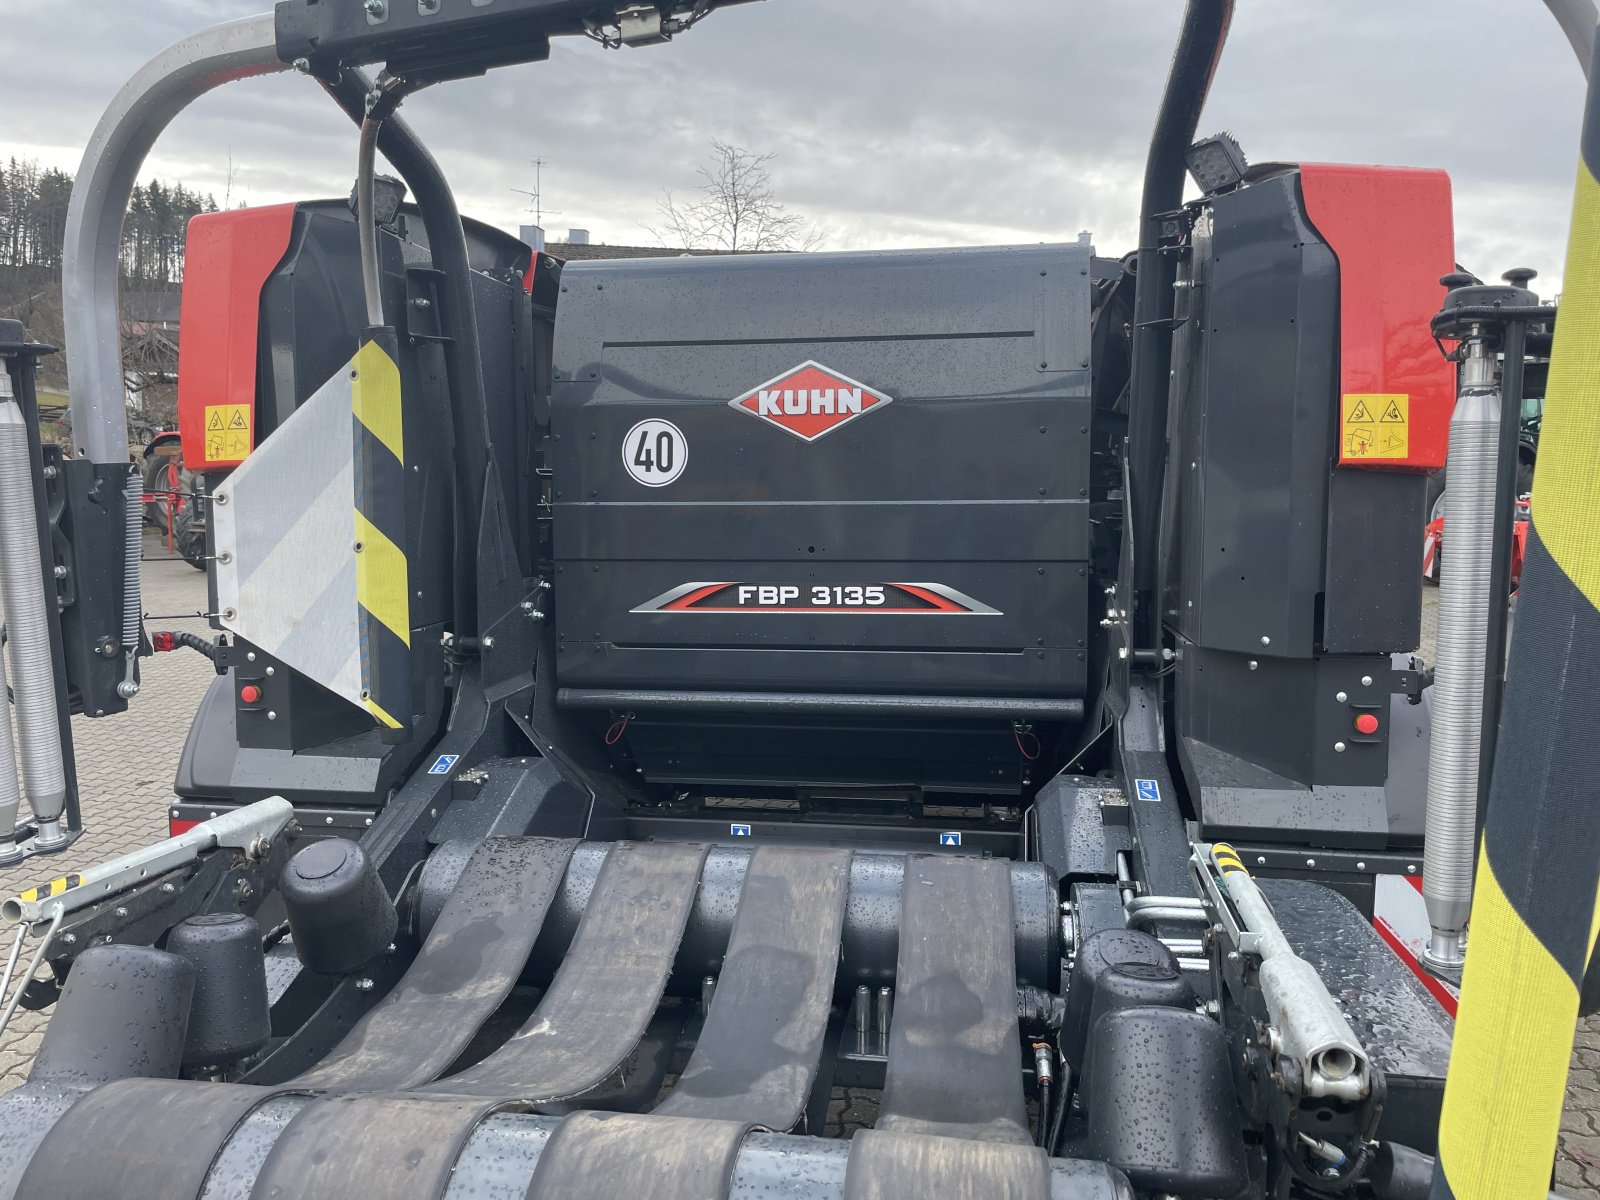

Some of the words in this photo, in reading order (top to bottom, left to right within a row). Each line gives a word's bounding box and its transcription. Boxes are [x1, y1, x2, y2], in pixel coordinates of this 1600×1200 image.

[758, 388, 862, 416] KUHN
[634, 431, 674, 473] 40
[738, 586, 799, 605] FBP
[811, 586, 885, 605] 3135
